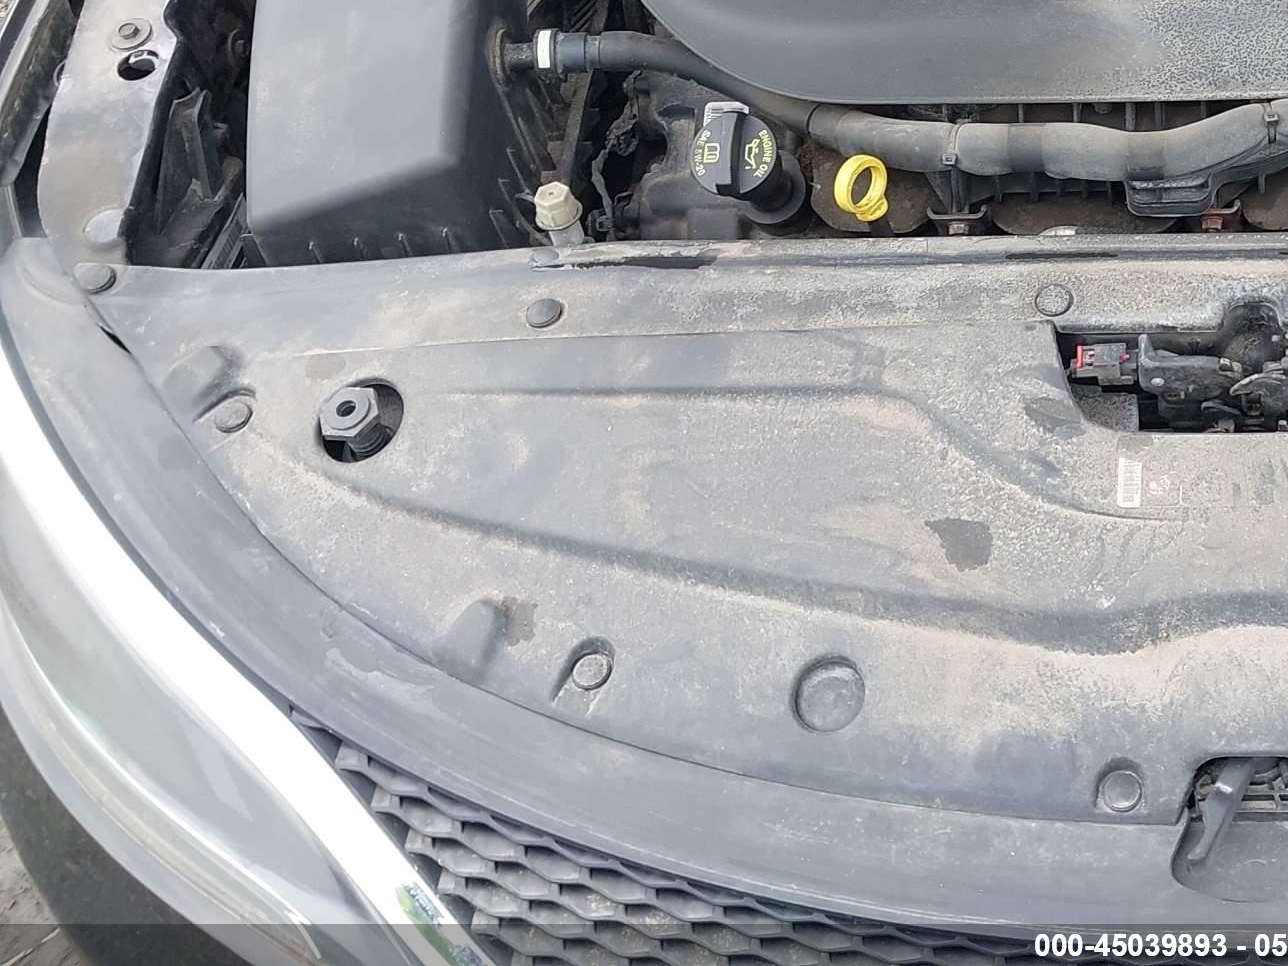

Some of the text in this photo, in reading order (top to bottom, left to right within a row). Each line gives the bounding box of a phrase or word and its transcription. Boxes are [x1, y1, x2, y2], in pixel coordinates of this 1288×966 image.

[696, 129, 711, 147] SAE
[694, 148, 706, 177] 5W-20
[753, 129, 774, 178] ENGINE OIL
